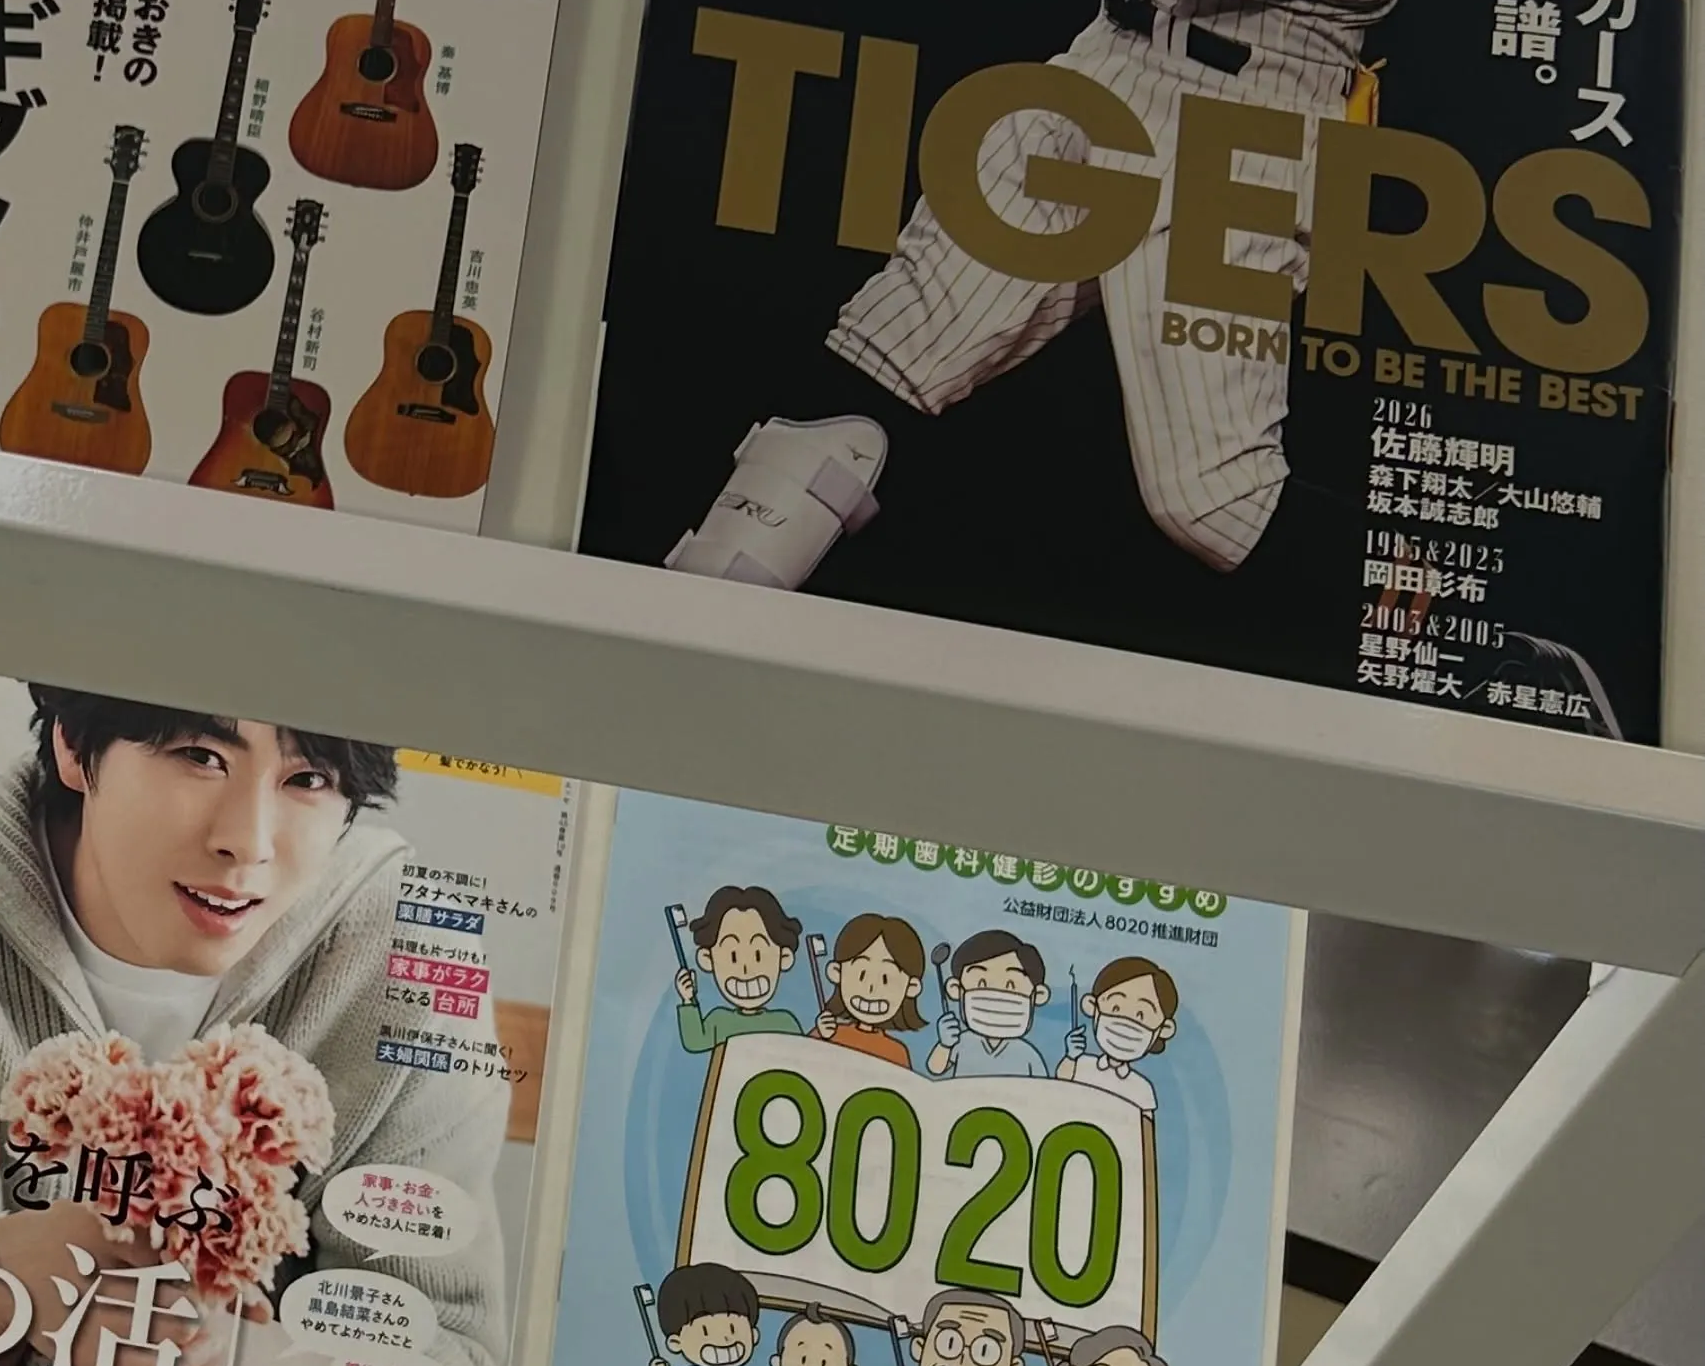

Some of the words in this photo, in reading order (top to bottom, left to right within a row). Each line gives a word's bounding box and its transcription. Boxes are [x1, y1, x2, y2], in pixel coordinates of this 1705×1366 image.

[691, 6, 1654, 375] TIGERS
[1161, 312, 1288, 365] BORN
[1301, 336, 1361, 378] TO
[1374, 350, 1426, 390] BE
[1440, 359, 1522, 405] THE
[1538, 377, 1644, 422] BEST
[1373, 397, 1434, 431] 2026
[1370, 425, 1516, 478] 佐藤輝明
[1366, 490, 1500, 531] 坂本誠志郎
[1363, 558, 1488, 603] 岡田彰布
[1358, 632, 1466, 668] 星野仙一
[401, 863, 488, 889] 初夏の不調に!
[389, 957, 488, 991] 家事がラク
[724, 1068, 1123, 1308] 8020
[317, 1279, 405, 1308] 北川景子さん
[300, 1317, 413, 1350] やめてよかったこと
